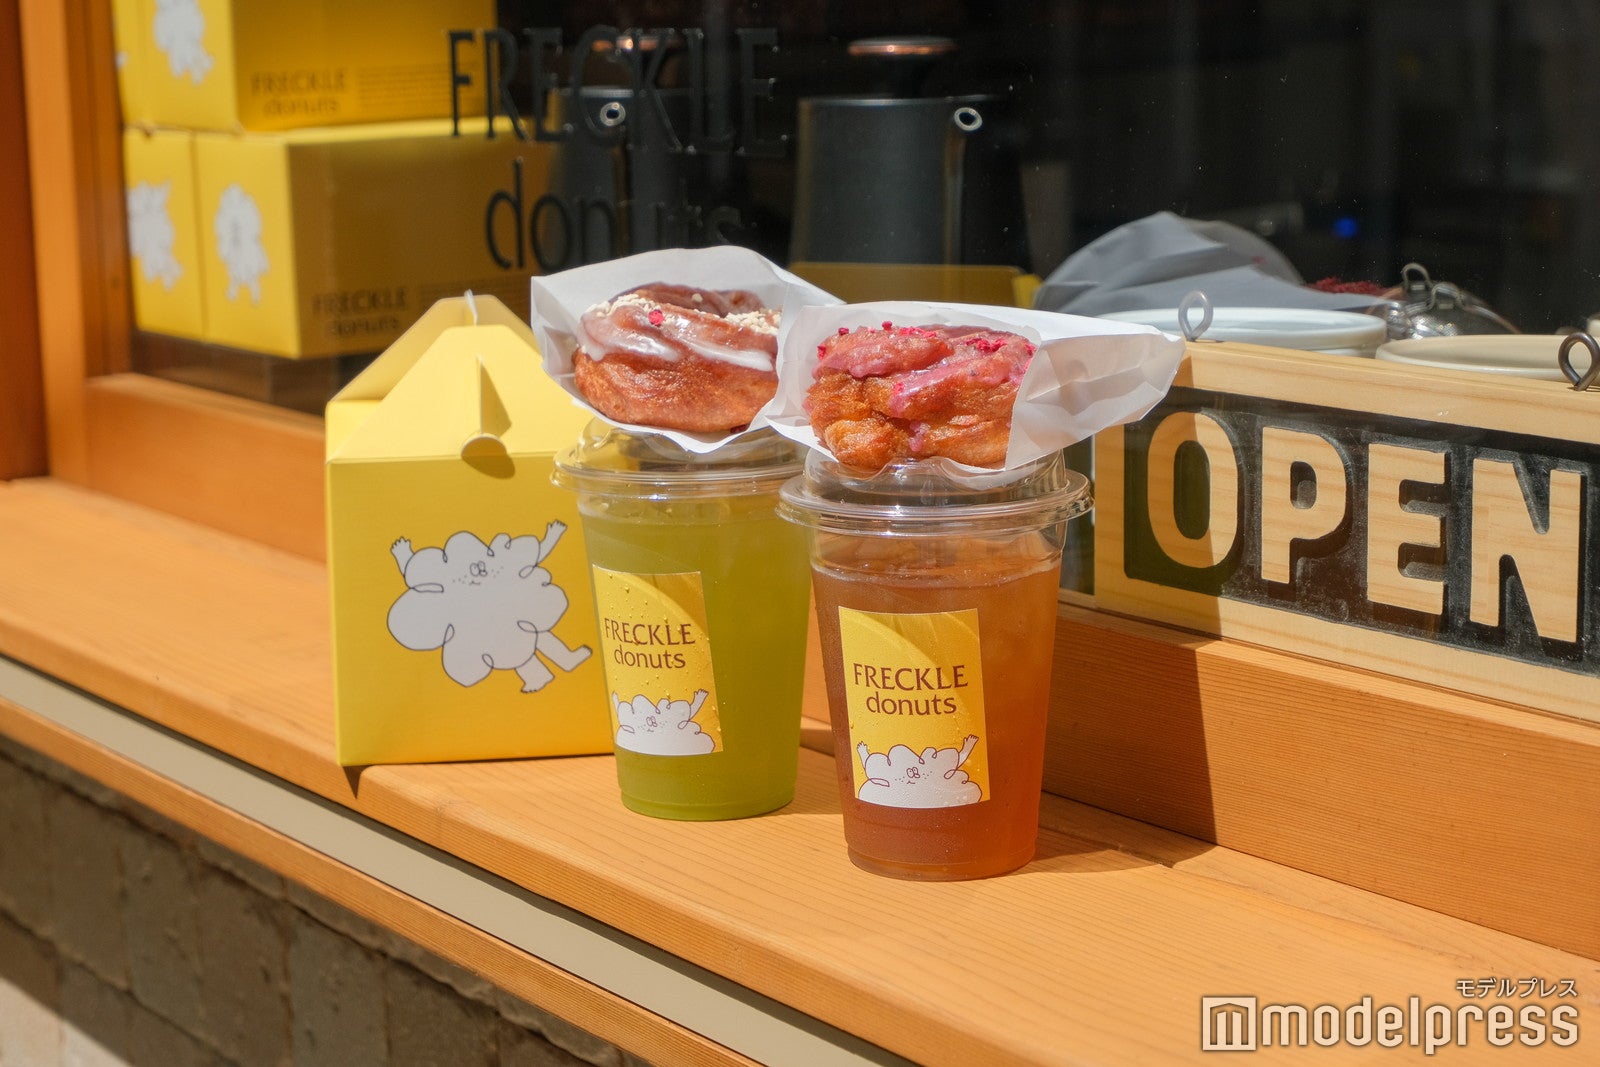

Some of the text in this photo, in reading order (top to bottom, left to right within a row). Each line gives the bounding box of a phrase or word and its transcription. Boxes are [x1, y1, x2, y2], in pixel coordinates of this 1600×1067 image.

[446, 25, 785, 154] FRECKLE
[1147, 411, 1582, 643] OPEN
[604, 618, 696, 646] FRECKLE
[614, 645, 686, 670] donuts
[853, 663, 969, 691] FRECKLE
[866, 692, 958, 717] donuts
